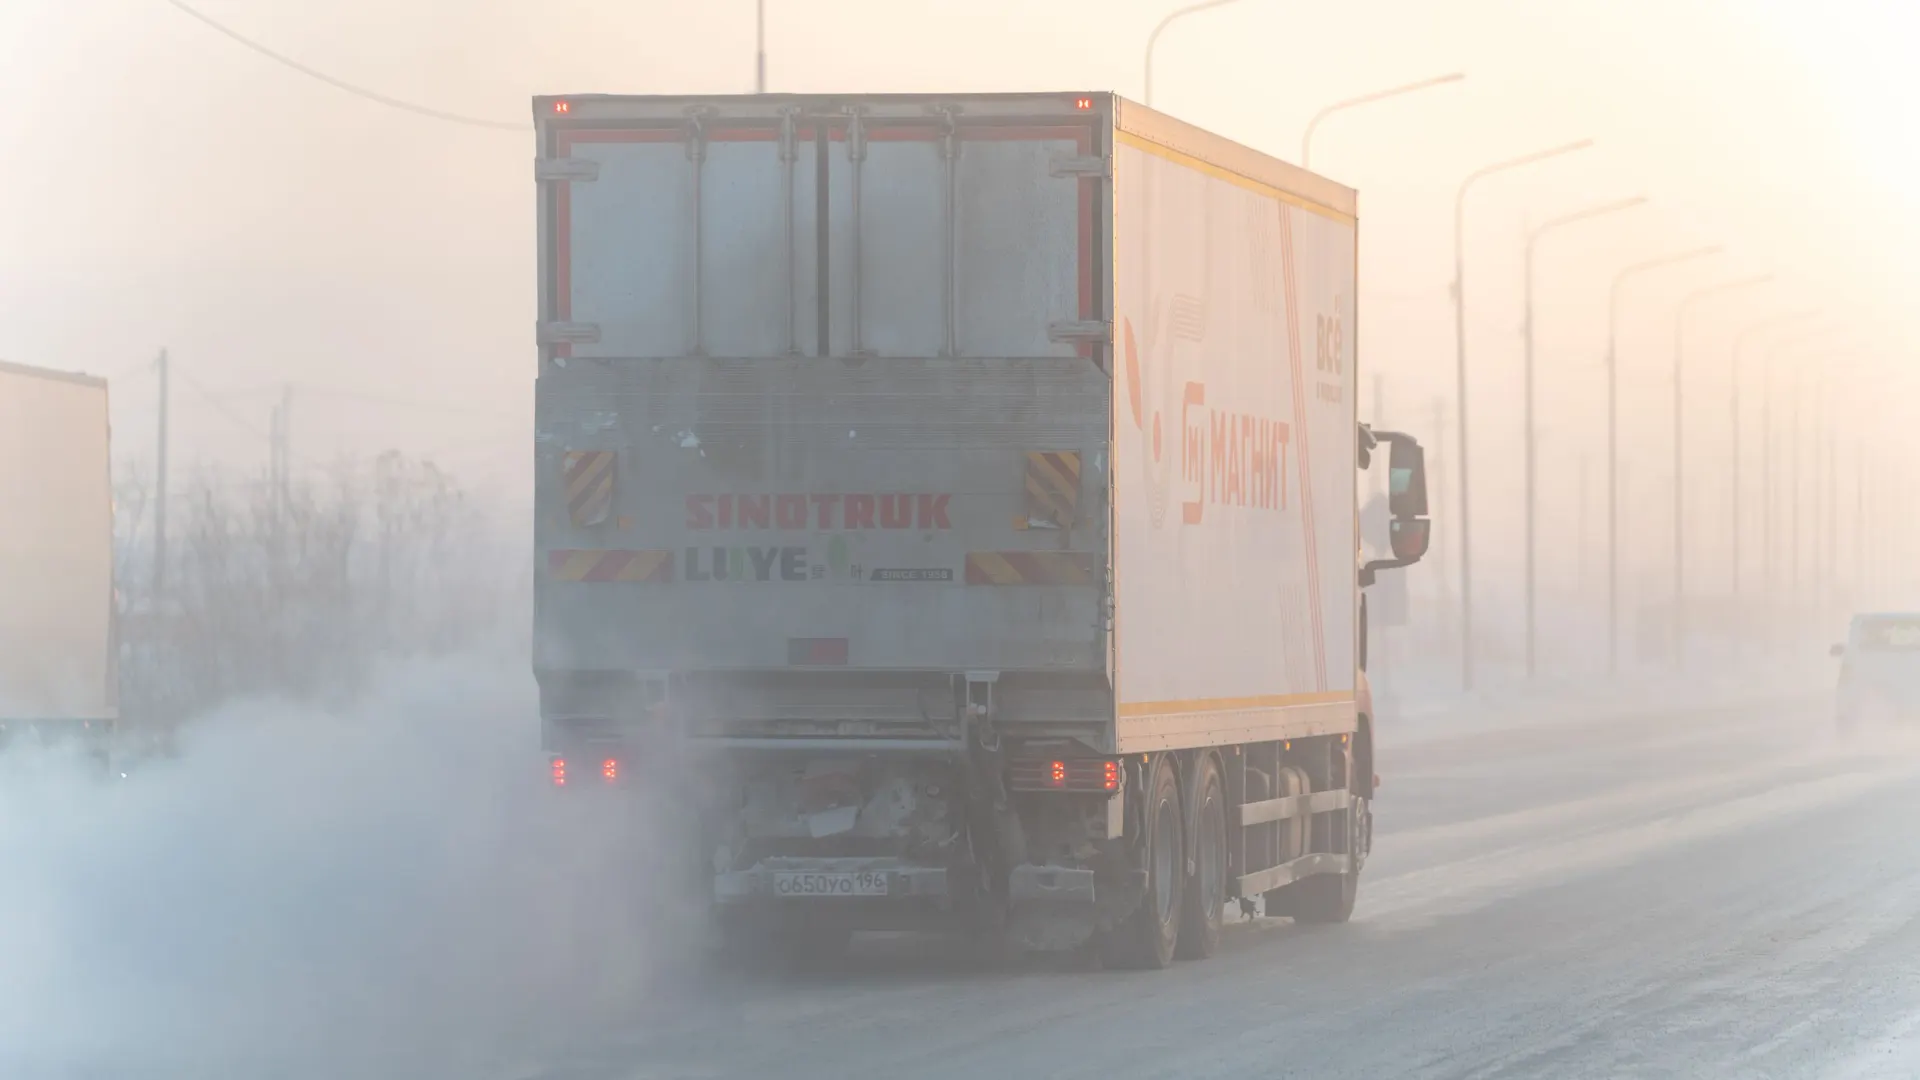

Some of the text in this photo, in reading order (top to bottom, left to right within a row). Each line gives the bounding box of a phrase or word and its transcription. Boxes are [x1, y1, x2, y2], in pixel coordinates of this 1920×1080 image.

[1210, 408, 1290, 511] МАГНИТ
[684, 493, 953, 530] SINOTRUK
[685, 546, 807, 582] LUYE
[881, 570, 917, 580] SINCE
